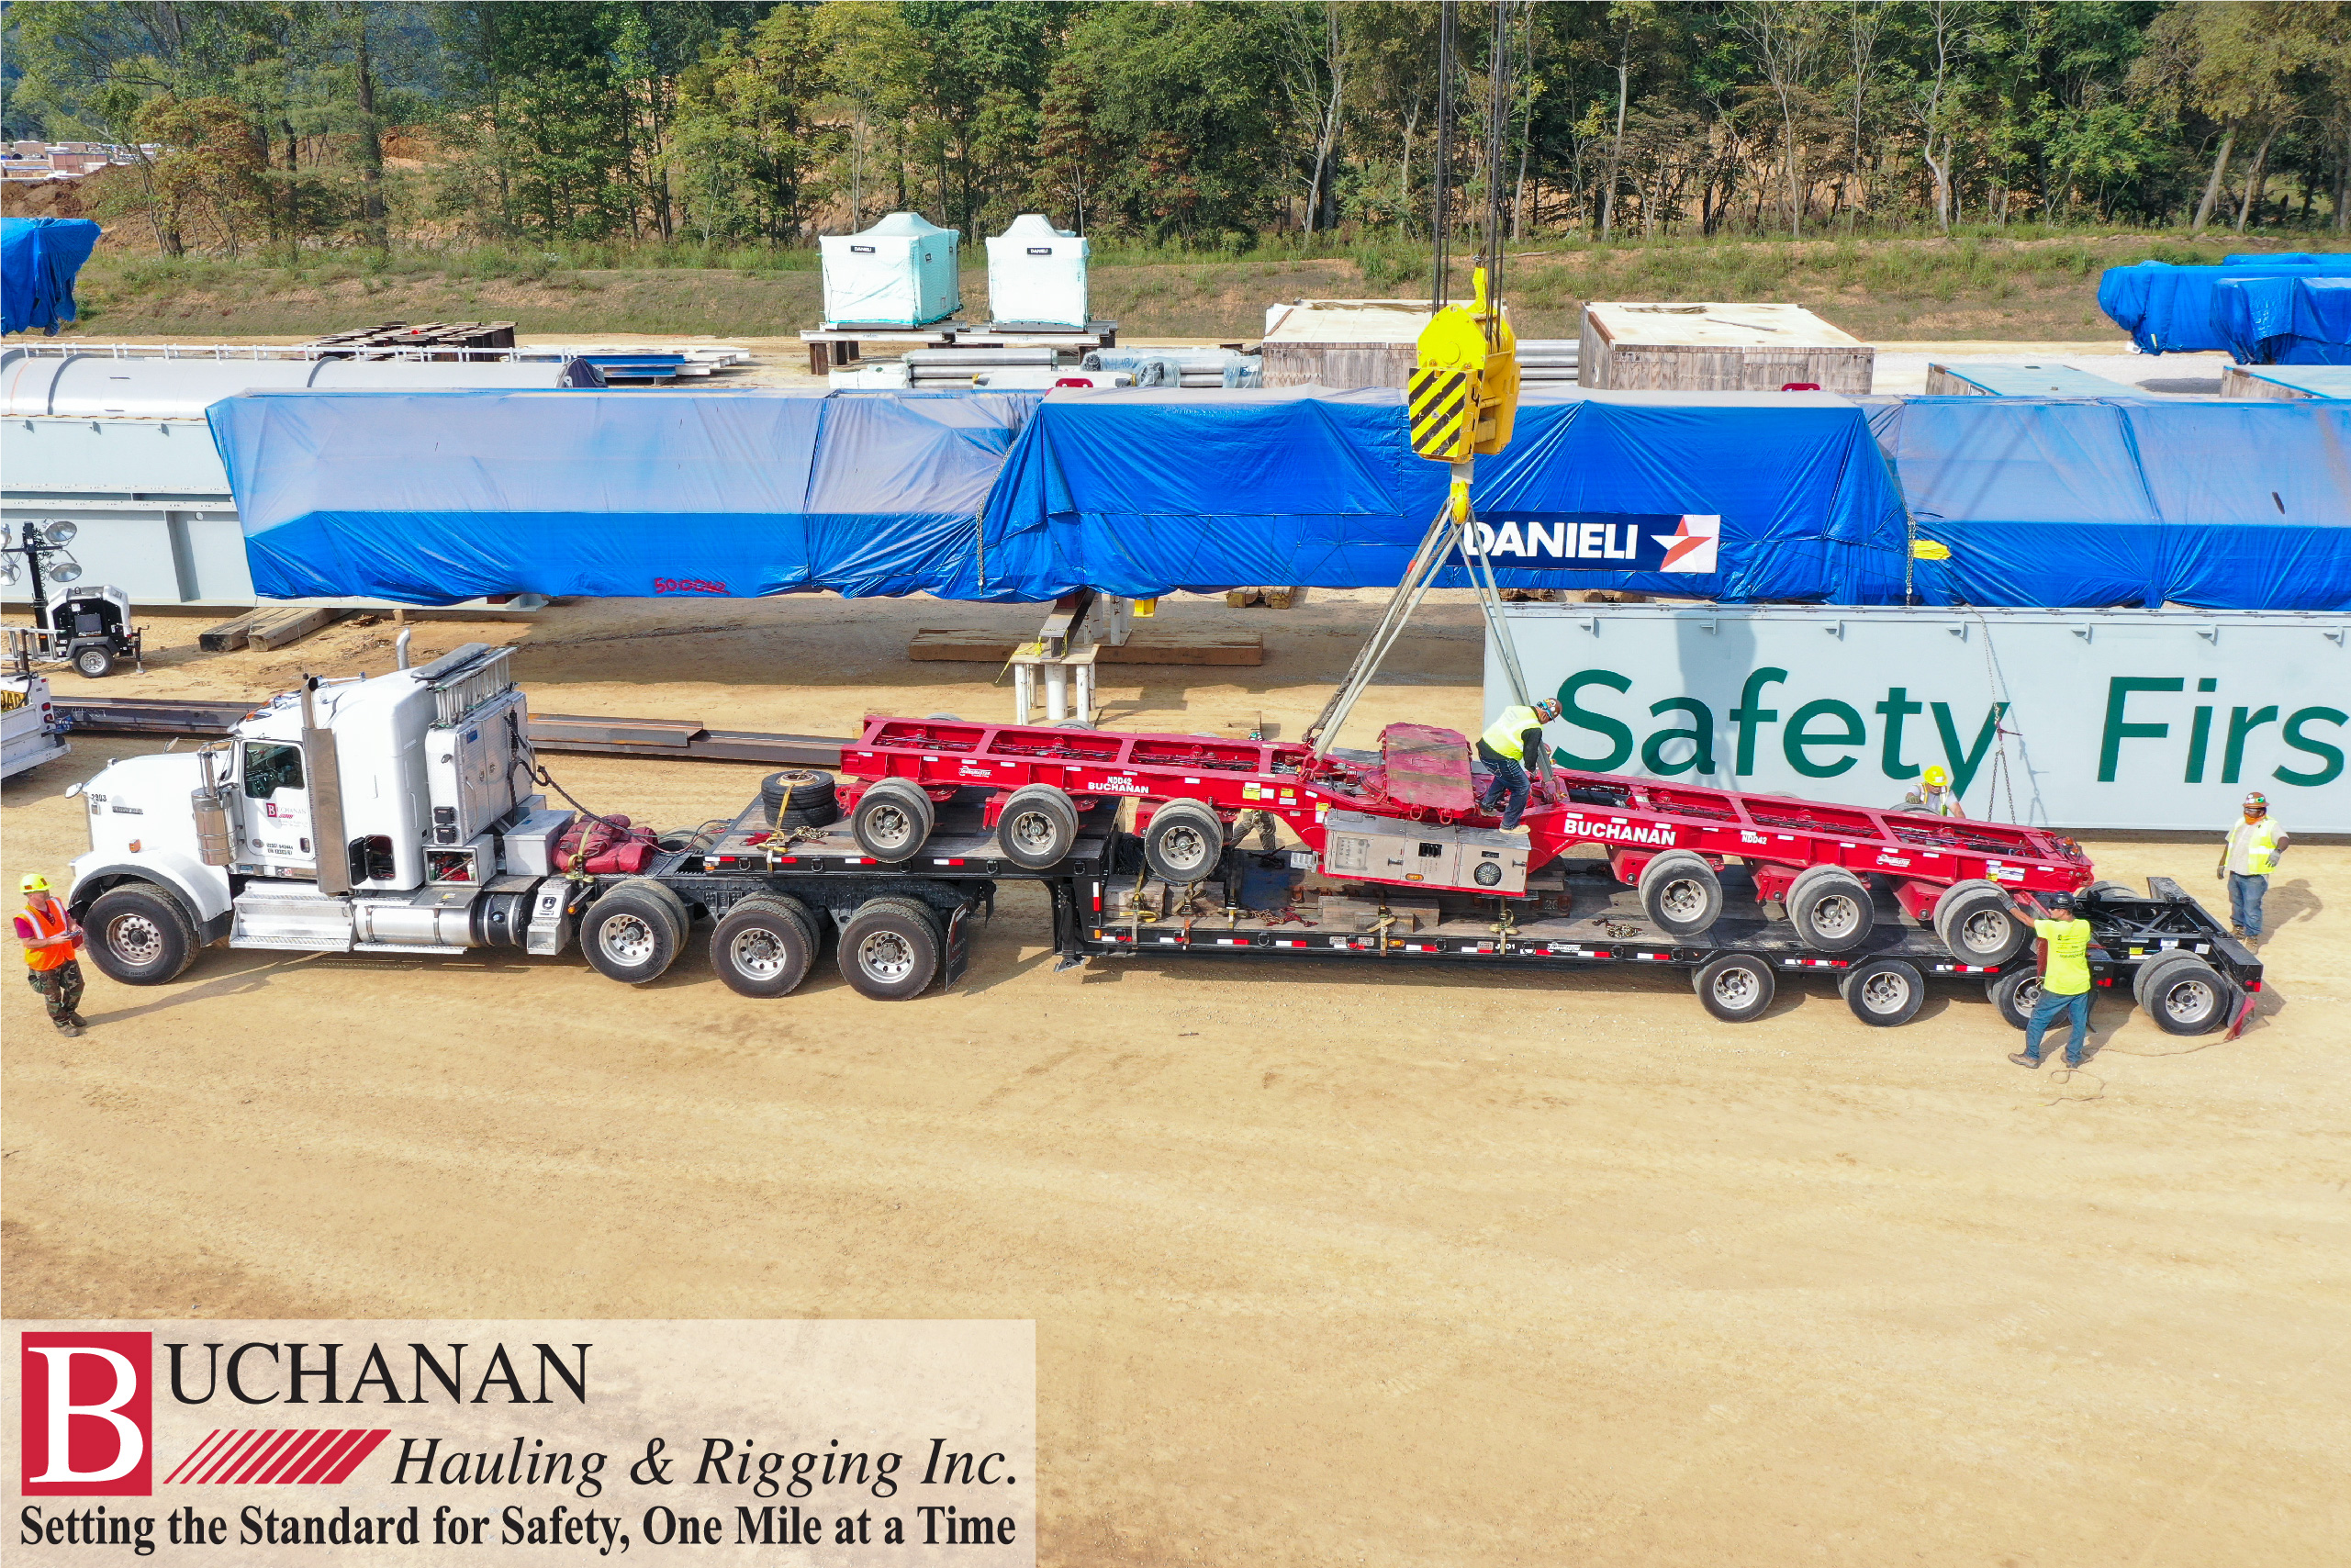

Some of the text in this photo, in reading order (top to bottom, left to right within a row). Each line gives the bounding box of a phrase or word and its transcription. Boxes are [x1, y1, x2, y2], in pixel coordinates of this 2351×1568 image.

[1463, 521, 1639, 560] DANIELI
[1551, 667, 2350, 801] Safety Firs
[1107, 776, 1133, 785] NDD42
[1088, 781, 1149, 793] BUCHANAN
[91, 794, 107, 802] 2903
[1563, 818, 1676, 846] BUCHANAN
[1741, 834, 1767, 845] NDD42
